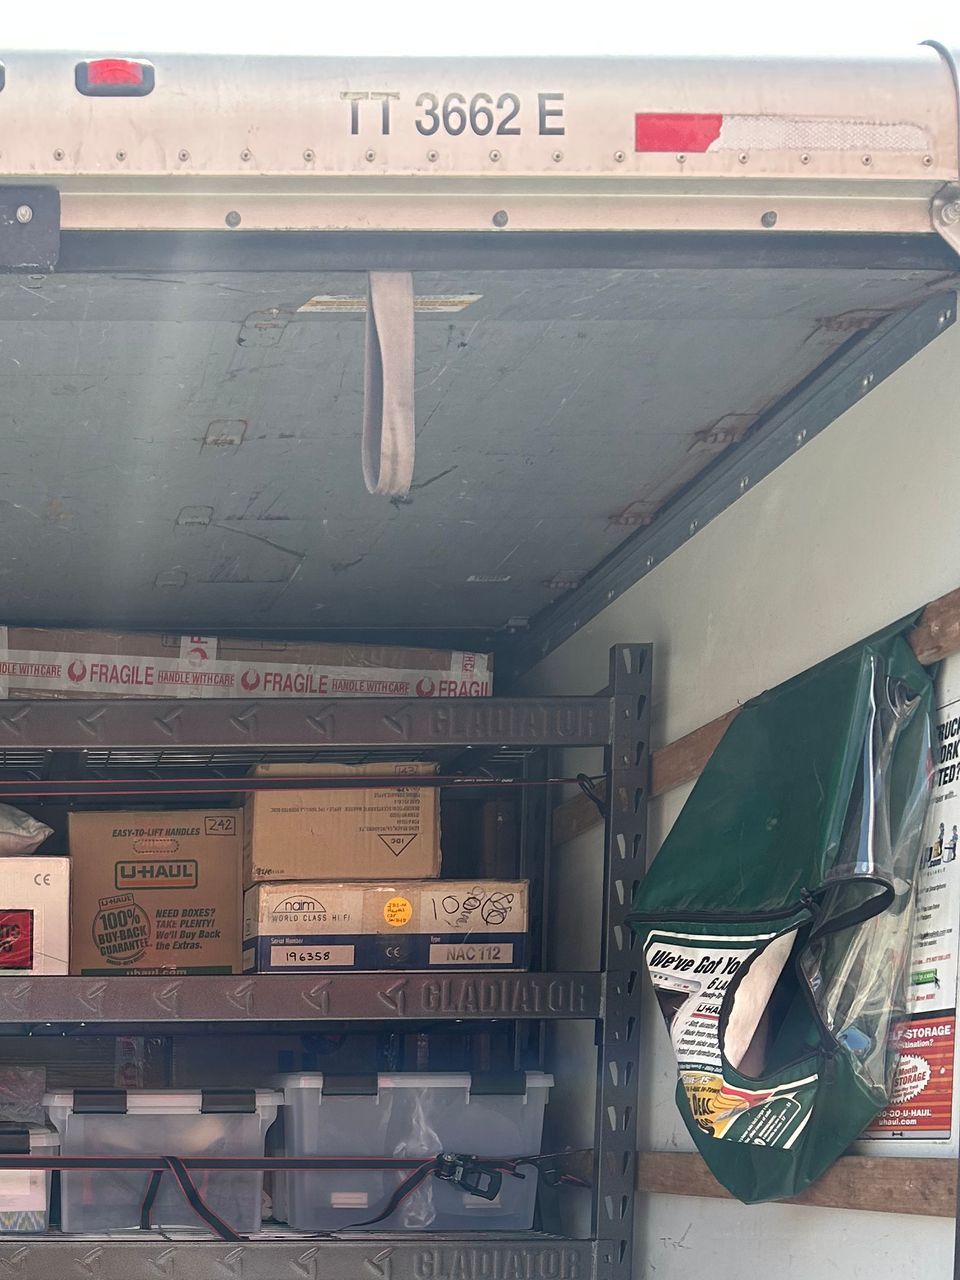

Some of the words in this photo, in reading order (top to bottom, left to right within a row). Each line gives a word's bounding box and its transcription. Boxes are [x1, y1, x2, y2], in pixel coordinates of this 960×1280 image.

[340, 92, 400, 135] TT
[415, 92, 521, 136] 3662
[538, 92, 565, 136] E
[19, 663, 40, 677] WITH
[41, 665, 62, 678] CARE
[90, 664, 154, 685] FRAGILE
[158, 671, 189, 684] HANDLE
[192, 672, 213, 685] WITH
[214, 673, 235, 687] CARE
[263, 672, 328, 693] FRAGILE
[333, 679, 364, 691] HANDLE
[367, 680, 388, 692] WITH
[389, 681, 409, 694] CARE
[112, 829, 164, 837] EASY-TO-LIFT
[165, 828, 200, 836] HANDLES
[209, 819, 232, 831] 242
[121, 865, 193, 878] U-HAUL
[101, 895, 132, 906] U-HAUL
[285, 900, 314, 911] naim
[100, 908, 140, 931] 100%
[156, 909, 178, 918] NEED
[181, 908, 215, 918] BOXES?
[272, 914, 298, 922] WORLD
[303, 914, 327, 922] CLASS
[156, 920, 176, 928] TAKE
[180, 919, 215, 928] PLENTY!
[98, 926, 147, 945] BUY-BACK
[156, 931, 177, 939] We'll
[179, 930, 196, 941] Buy
[199, 930, 220, 938] Back
[156, 942, 170, 950] the
[172, 941, 202, 950] Extras.
[446, 946, 475, 961] NAC
[478, 945, 501, 960] 112
[286, 951, 330, 961] 196358
[649, 950, 695, 971] We've
[693, 956, 723, 974] Got
[720, 957, 741, 975] Yo
[707, 977, 719, 990] 6
[421, 981, 585, 1012] GLADIATOR
[893, 1025, 951, 1040] LF-STORAGE
[895, 1071, 926, 1087] STORAGE
[414, 1250, 580, 1280] GLADIATOR
